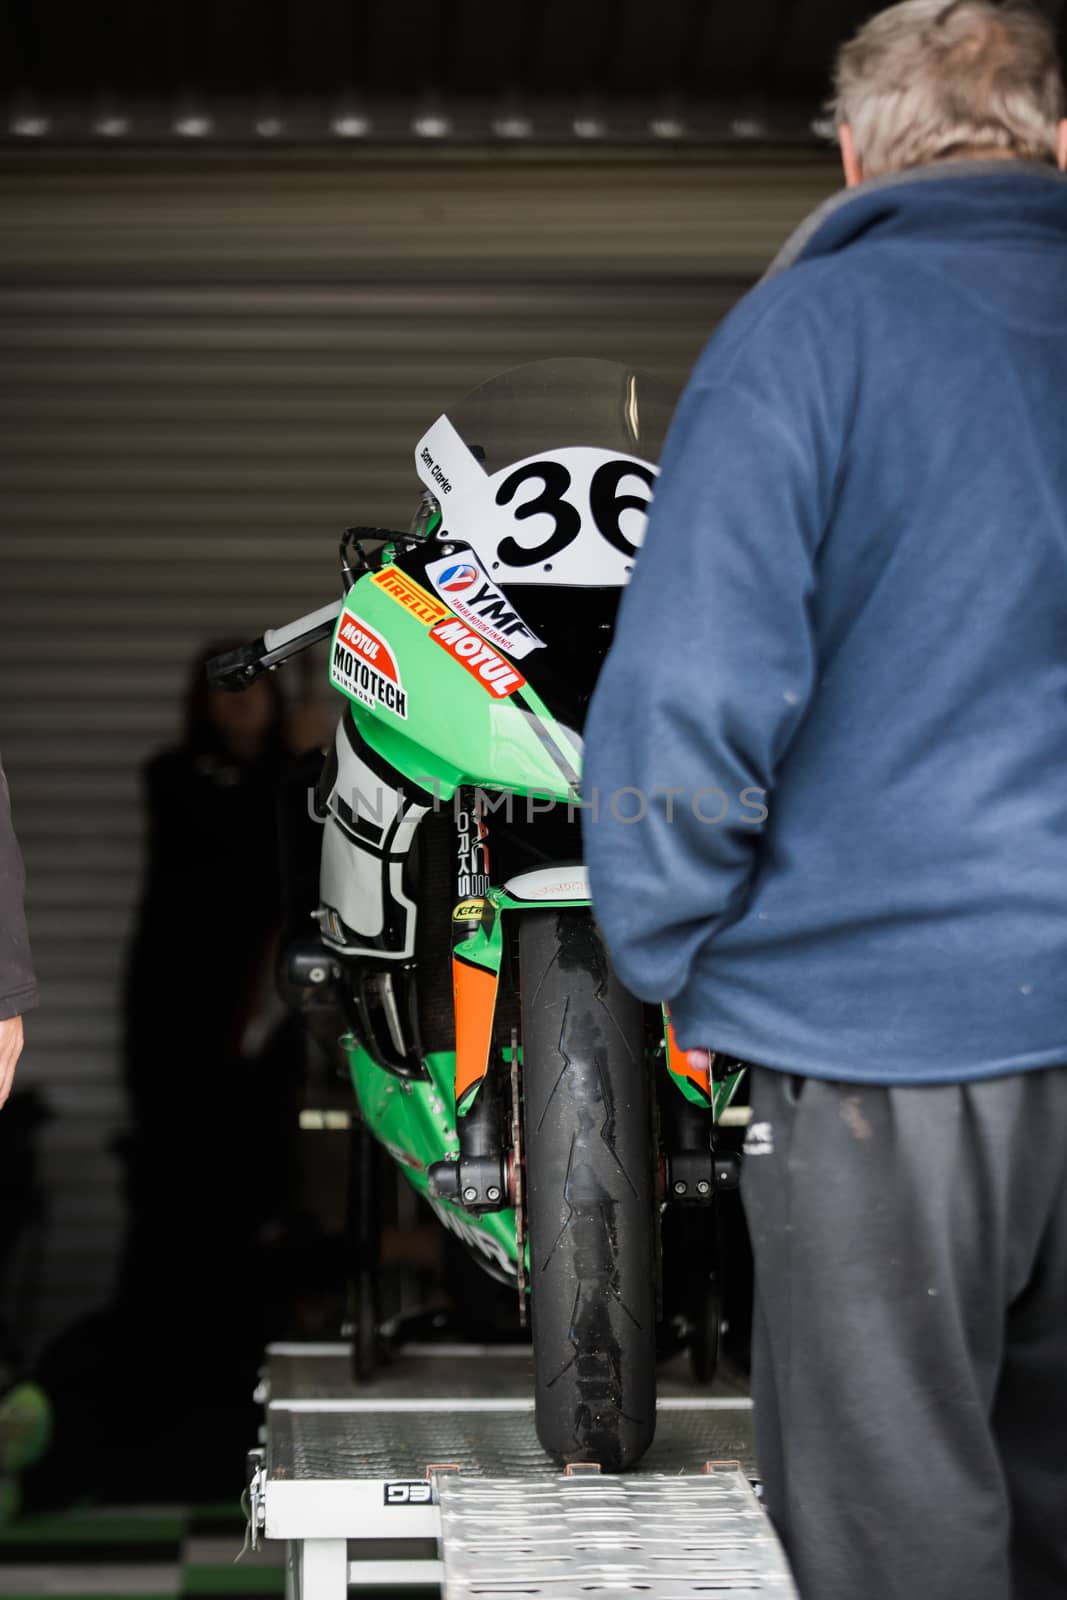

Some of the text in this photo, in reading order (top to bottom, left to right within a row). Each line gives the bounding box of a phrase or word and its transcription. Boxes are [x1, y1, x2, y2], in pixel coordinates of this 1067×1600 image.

[420, 447, 452, 495] Sam Clarke
[495, 460, 657, 567] 36
[375, 568, 446, 622] PIRELLI
[450, 597, 515, 650] YAMAHA MOTOR FINANCE
[340, 622, 381, 660] MOTUL
[432, 620, 520, 696] MOTUL
[333, 642, 406, 718] MOTOTECH
[457, 811, 470, 897] ORKS
